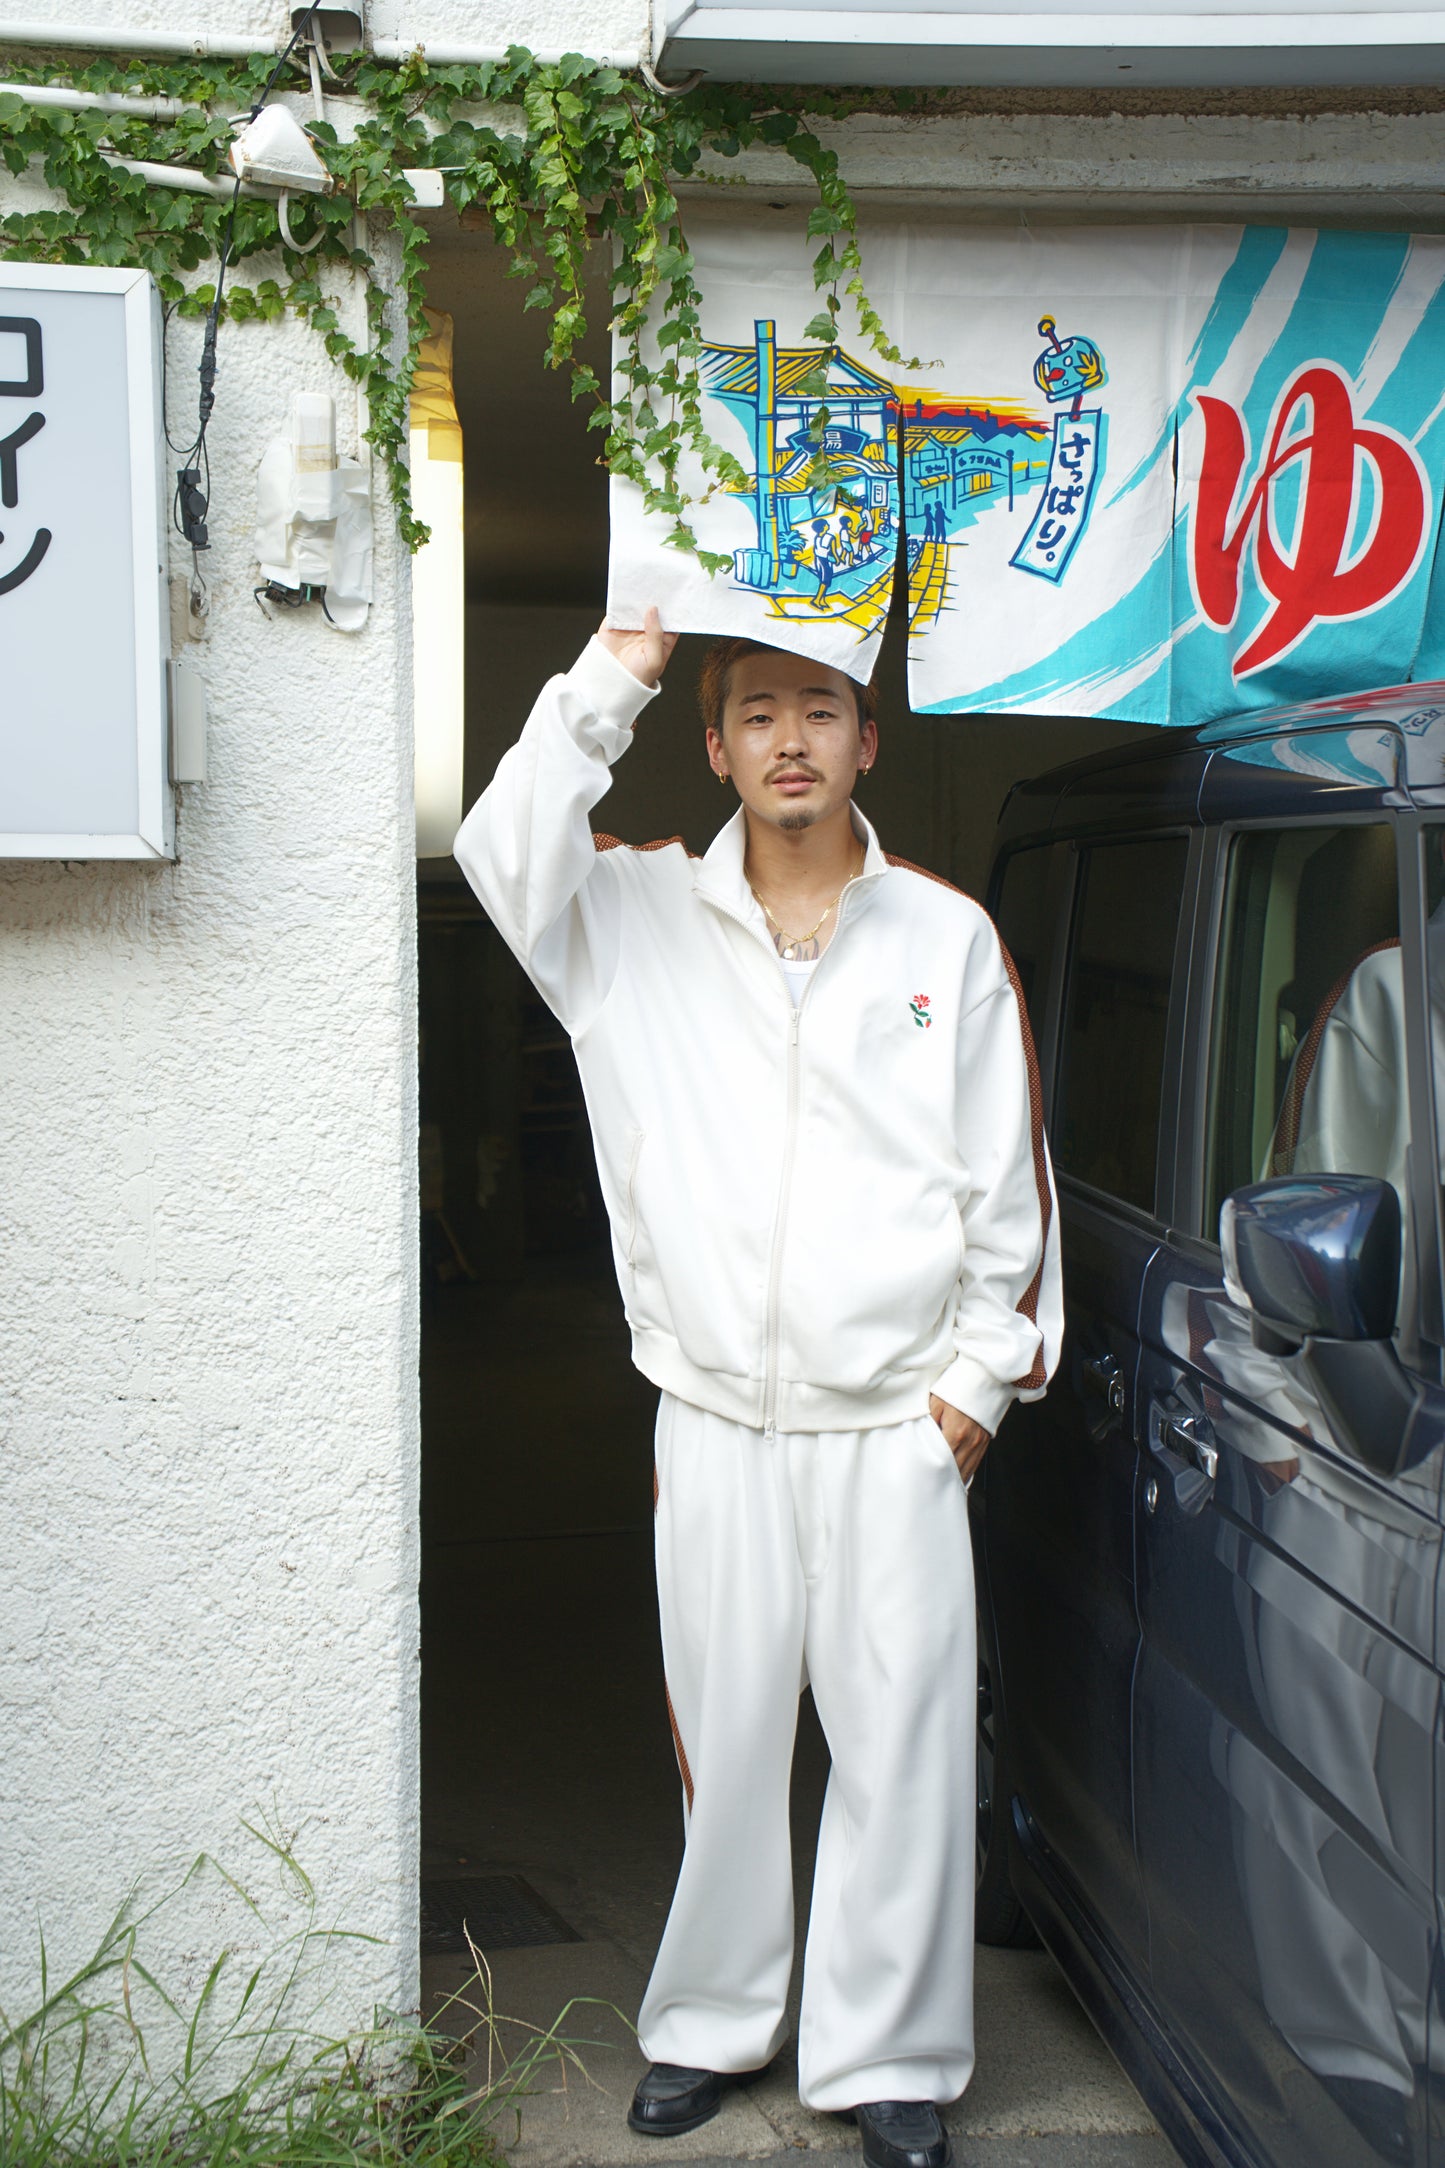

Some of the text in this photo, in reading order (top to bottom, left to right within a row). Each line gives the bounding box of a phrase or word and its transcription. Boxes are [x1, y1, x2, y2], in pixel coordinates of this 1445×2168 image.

[1035, 432, 1092, 562] さっぱり。
[1193, 366, 1425, 677] ゆ
